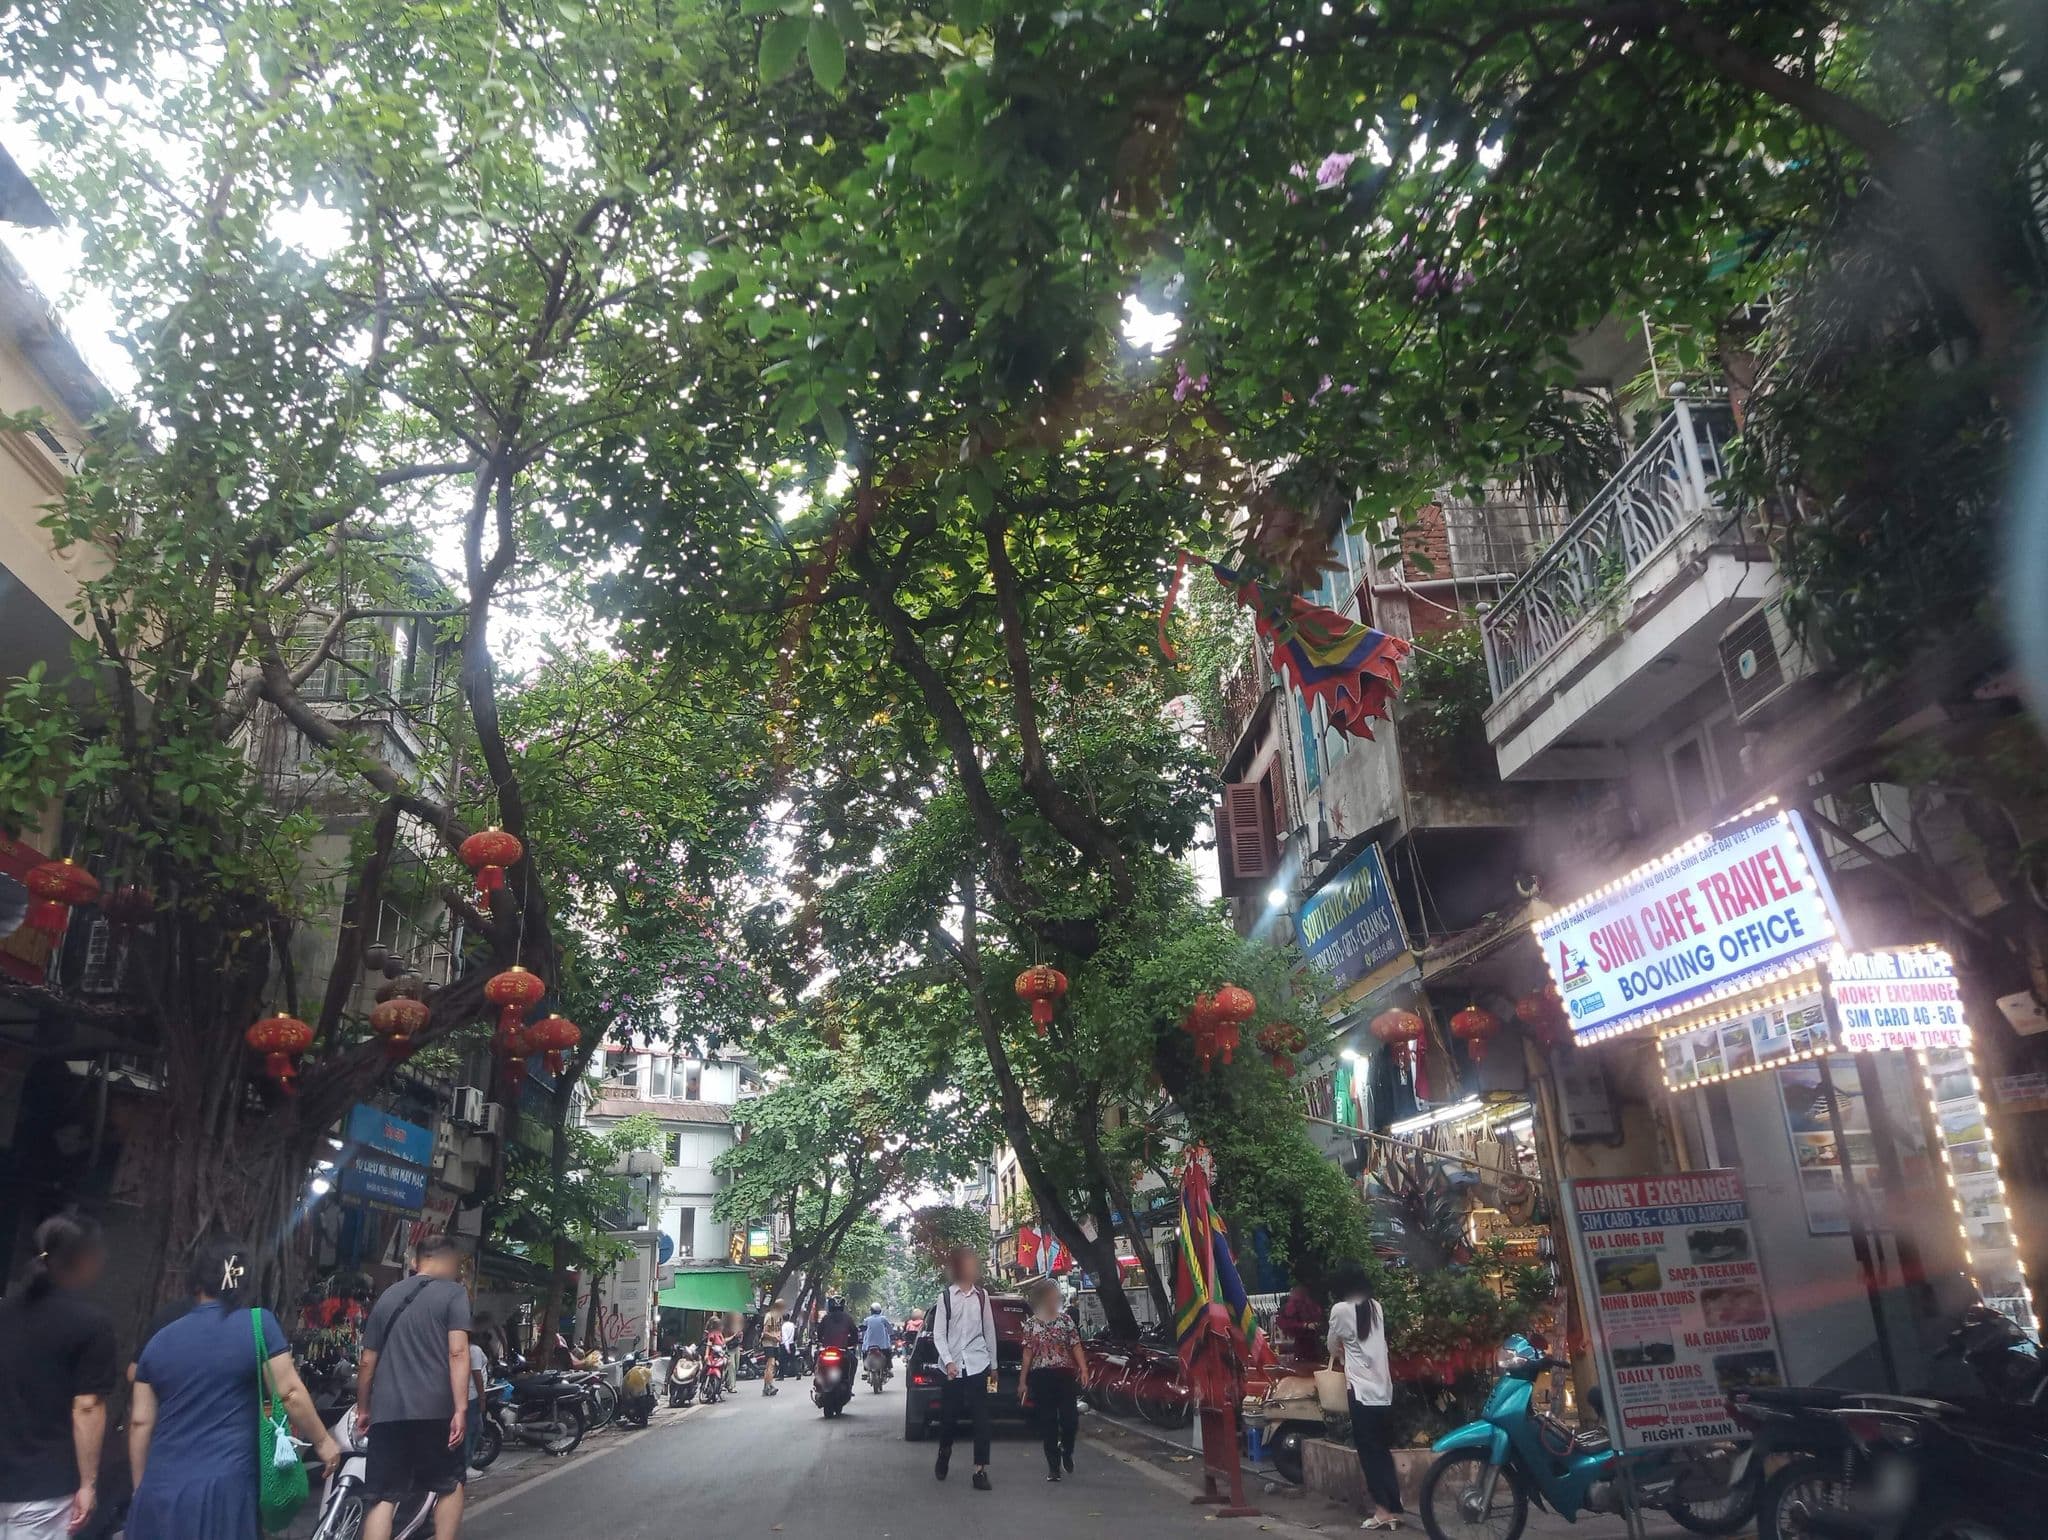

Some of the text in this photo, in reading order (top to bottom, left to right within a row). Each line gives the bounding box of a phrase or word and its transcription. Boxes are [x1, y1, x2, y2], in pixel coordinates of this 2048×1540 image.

[1302, 867, 1372, 947] SOUVENIR SHOP
[1589, 915, 1645, 974] SINH
[1640, 888, 1705, 951] CAFE
[1698, 845, 1803, 926] TRAVEL
[1617, 944, 1715, 1002] BOOKING
[1719, 908, 1804, 962] OFFICE
[1837, 983, 1956, 1005] MONEY EXCHANGE
[1846, 1009, 1872, 1028] SIM
[1875, 1007, 1910, 1027] CARD
[1914, 1006, 1930, 1025] 4G
[1938, 1005, 1957, 1025] 5G
[1575, 1176, 1741, 1211] MONEY EXCHANGE
[1582, 1213, 1604, 1231] SIM
[1604, 1211, 1632, 1229] CARD
[1636, 1210, 1649, 1226] 5G
[1658, 1208, 1680, 1225] CAR
[1682, 1206, 1697, 1223] TO
[1699, 1203, 1745, 1222] AIRPORT
[1588, 1230, 1666, 1250] HA LONG BAY
[1668, 1266, 1698, 1282] SAPA
[1699, 1262, 1757, 1280] TREKKING
[1600, 1290, 1697, 1311] NINH BINH TOURS
[1684, 1326, 1772, 1347] HA GIANG LOOP
[1617, 1364, 1703, 1385] DAILY TOURS
[1641, 1426, 1685, 1442] FILGHT
[1695, 1422, 1733, 1437] TRAIN
